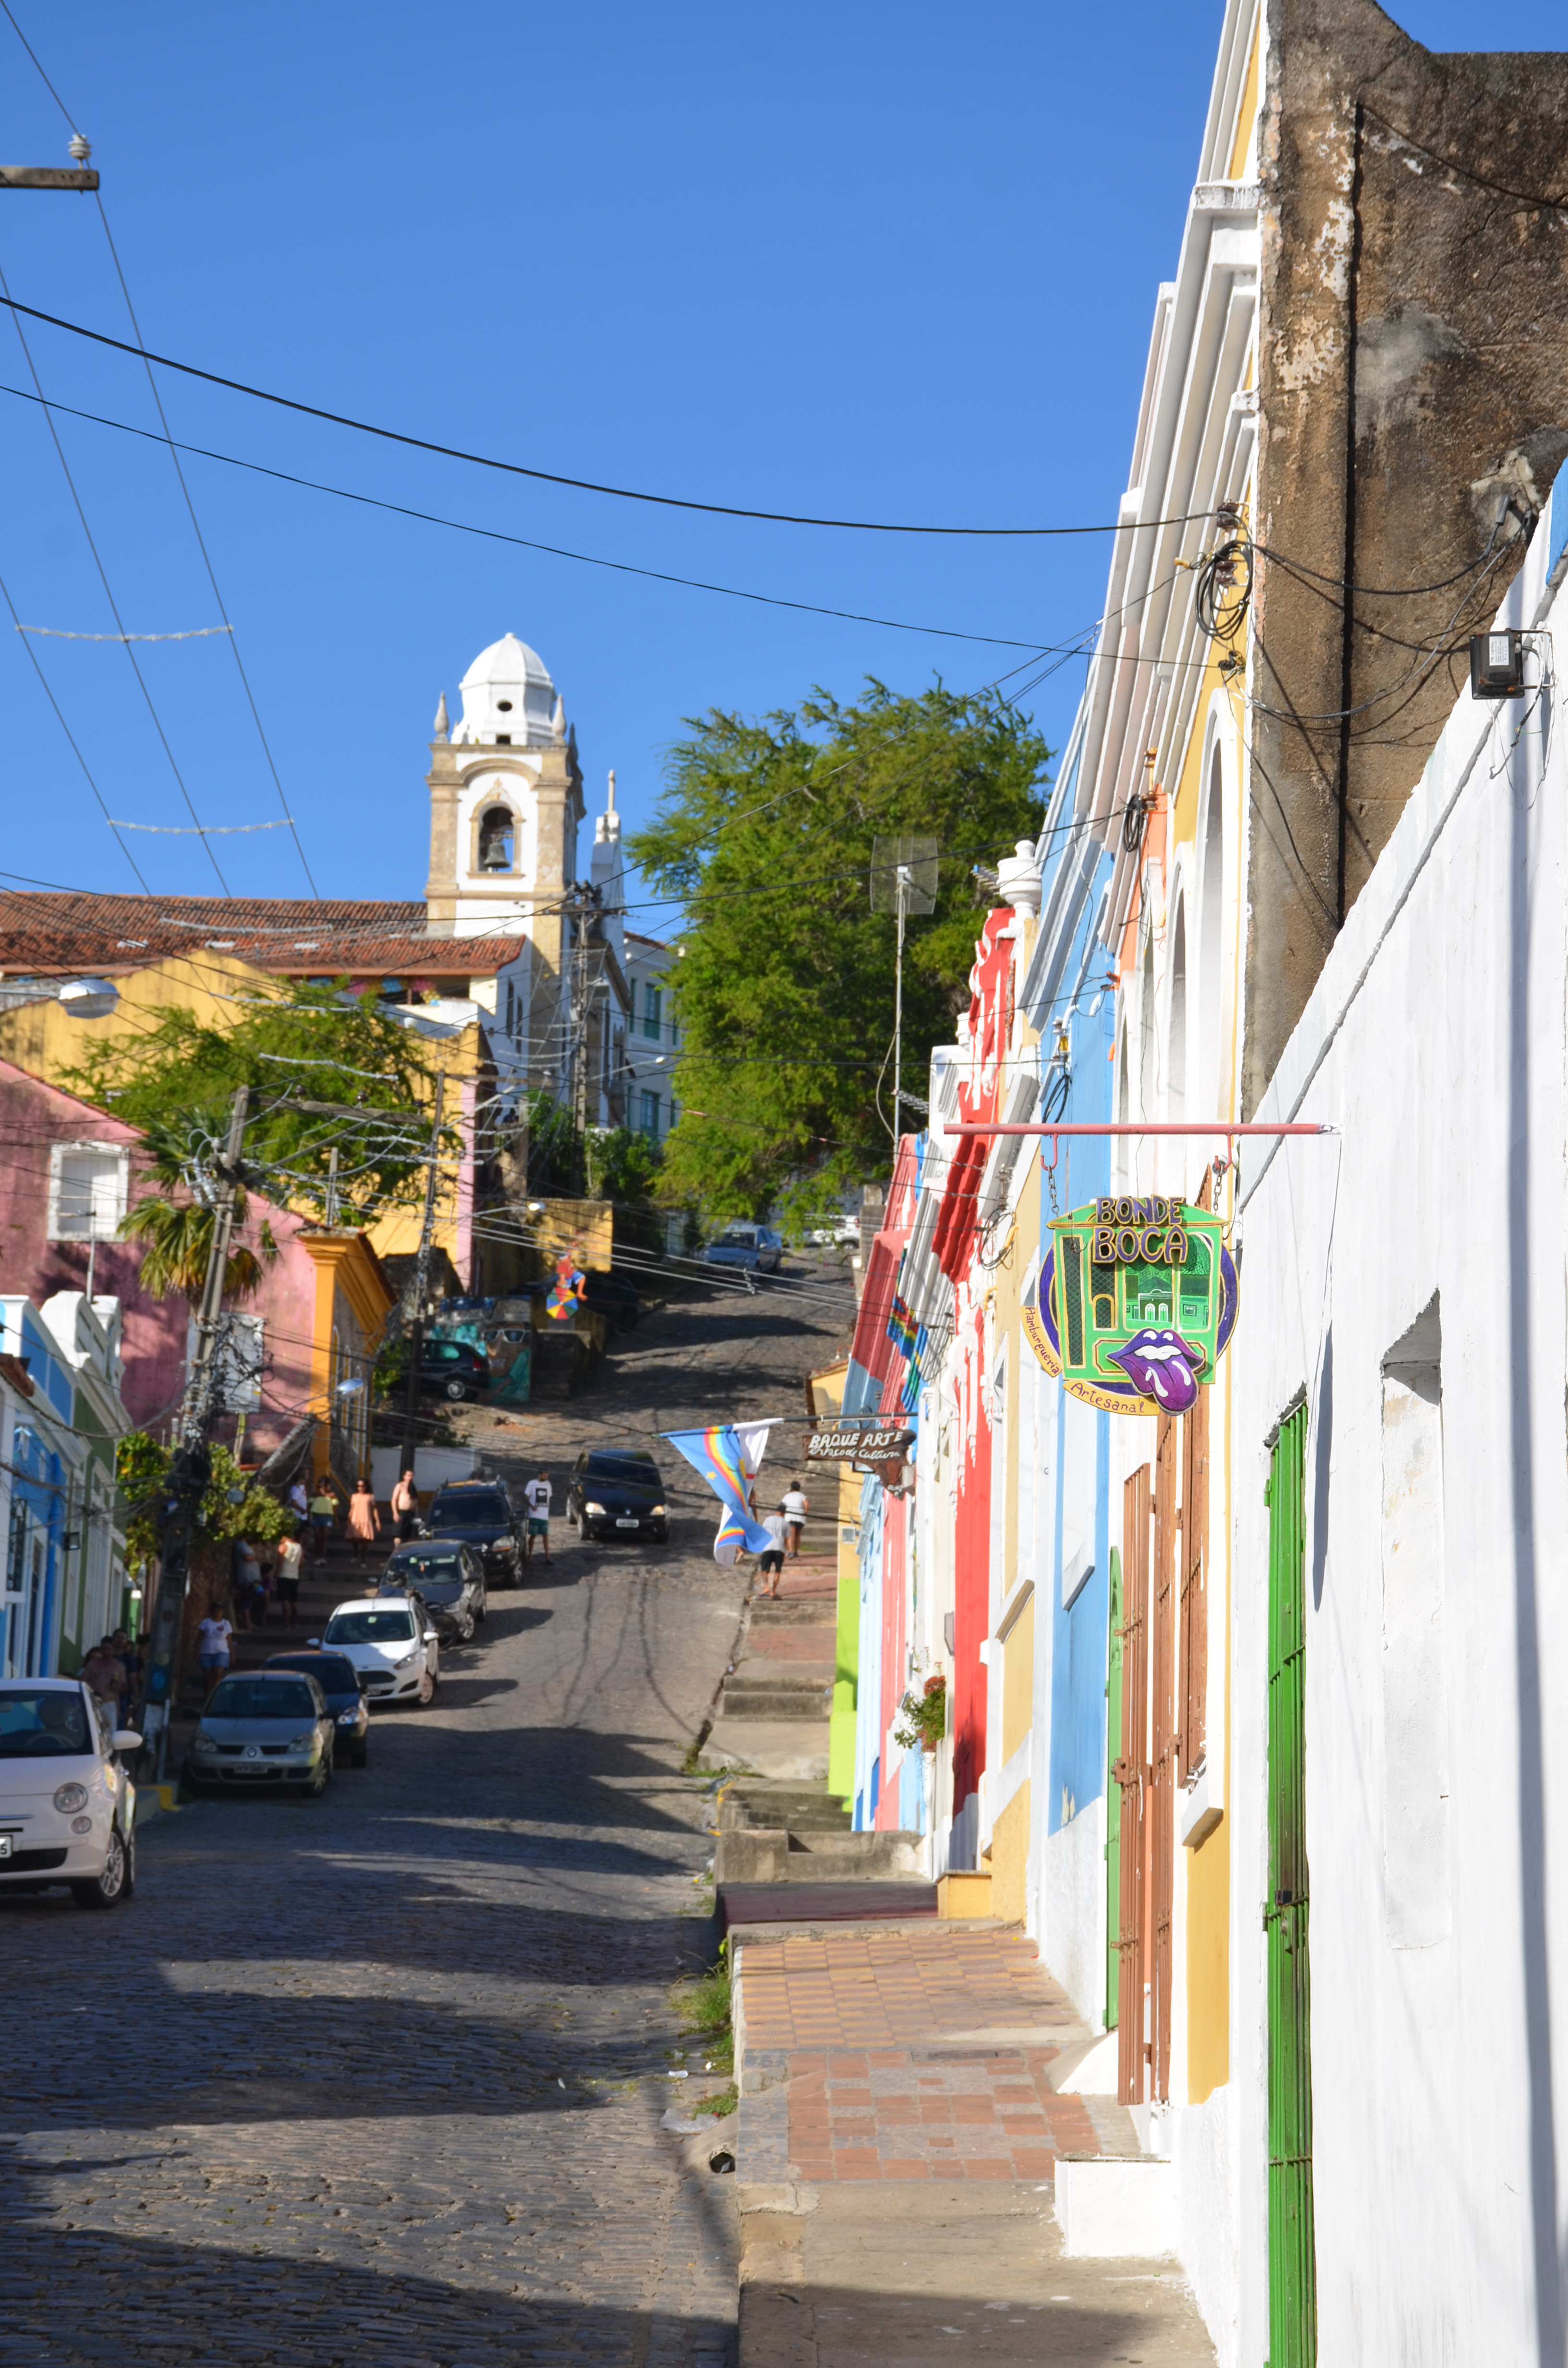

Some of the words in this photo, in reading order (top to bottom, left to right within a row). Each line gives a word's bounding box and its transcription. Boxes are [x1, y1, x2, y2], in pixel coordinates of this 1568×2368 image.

[1096, 1195, 1186, 1224] BONDE
[1093, 1224, 1188, 1263] BOCA
[1025, 1307, 1059, 1375] Hamburgueria
[1070, 1382, 1145, 1413] Artesanal
[808, 1432, 860, 1448] BAQUE
[860, 1431, 904, 1448] ARTE
[858, 1449, 901, 1460] Cultura
